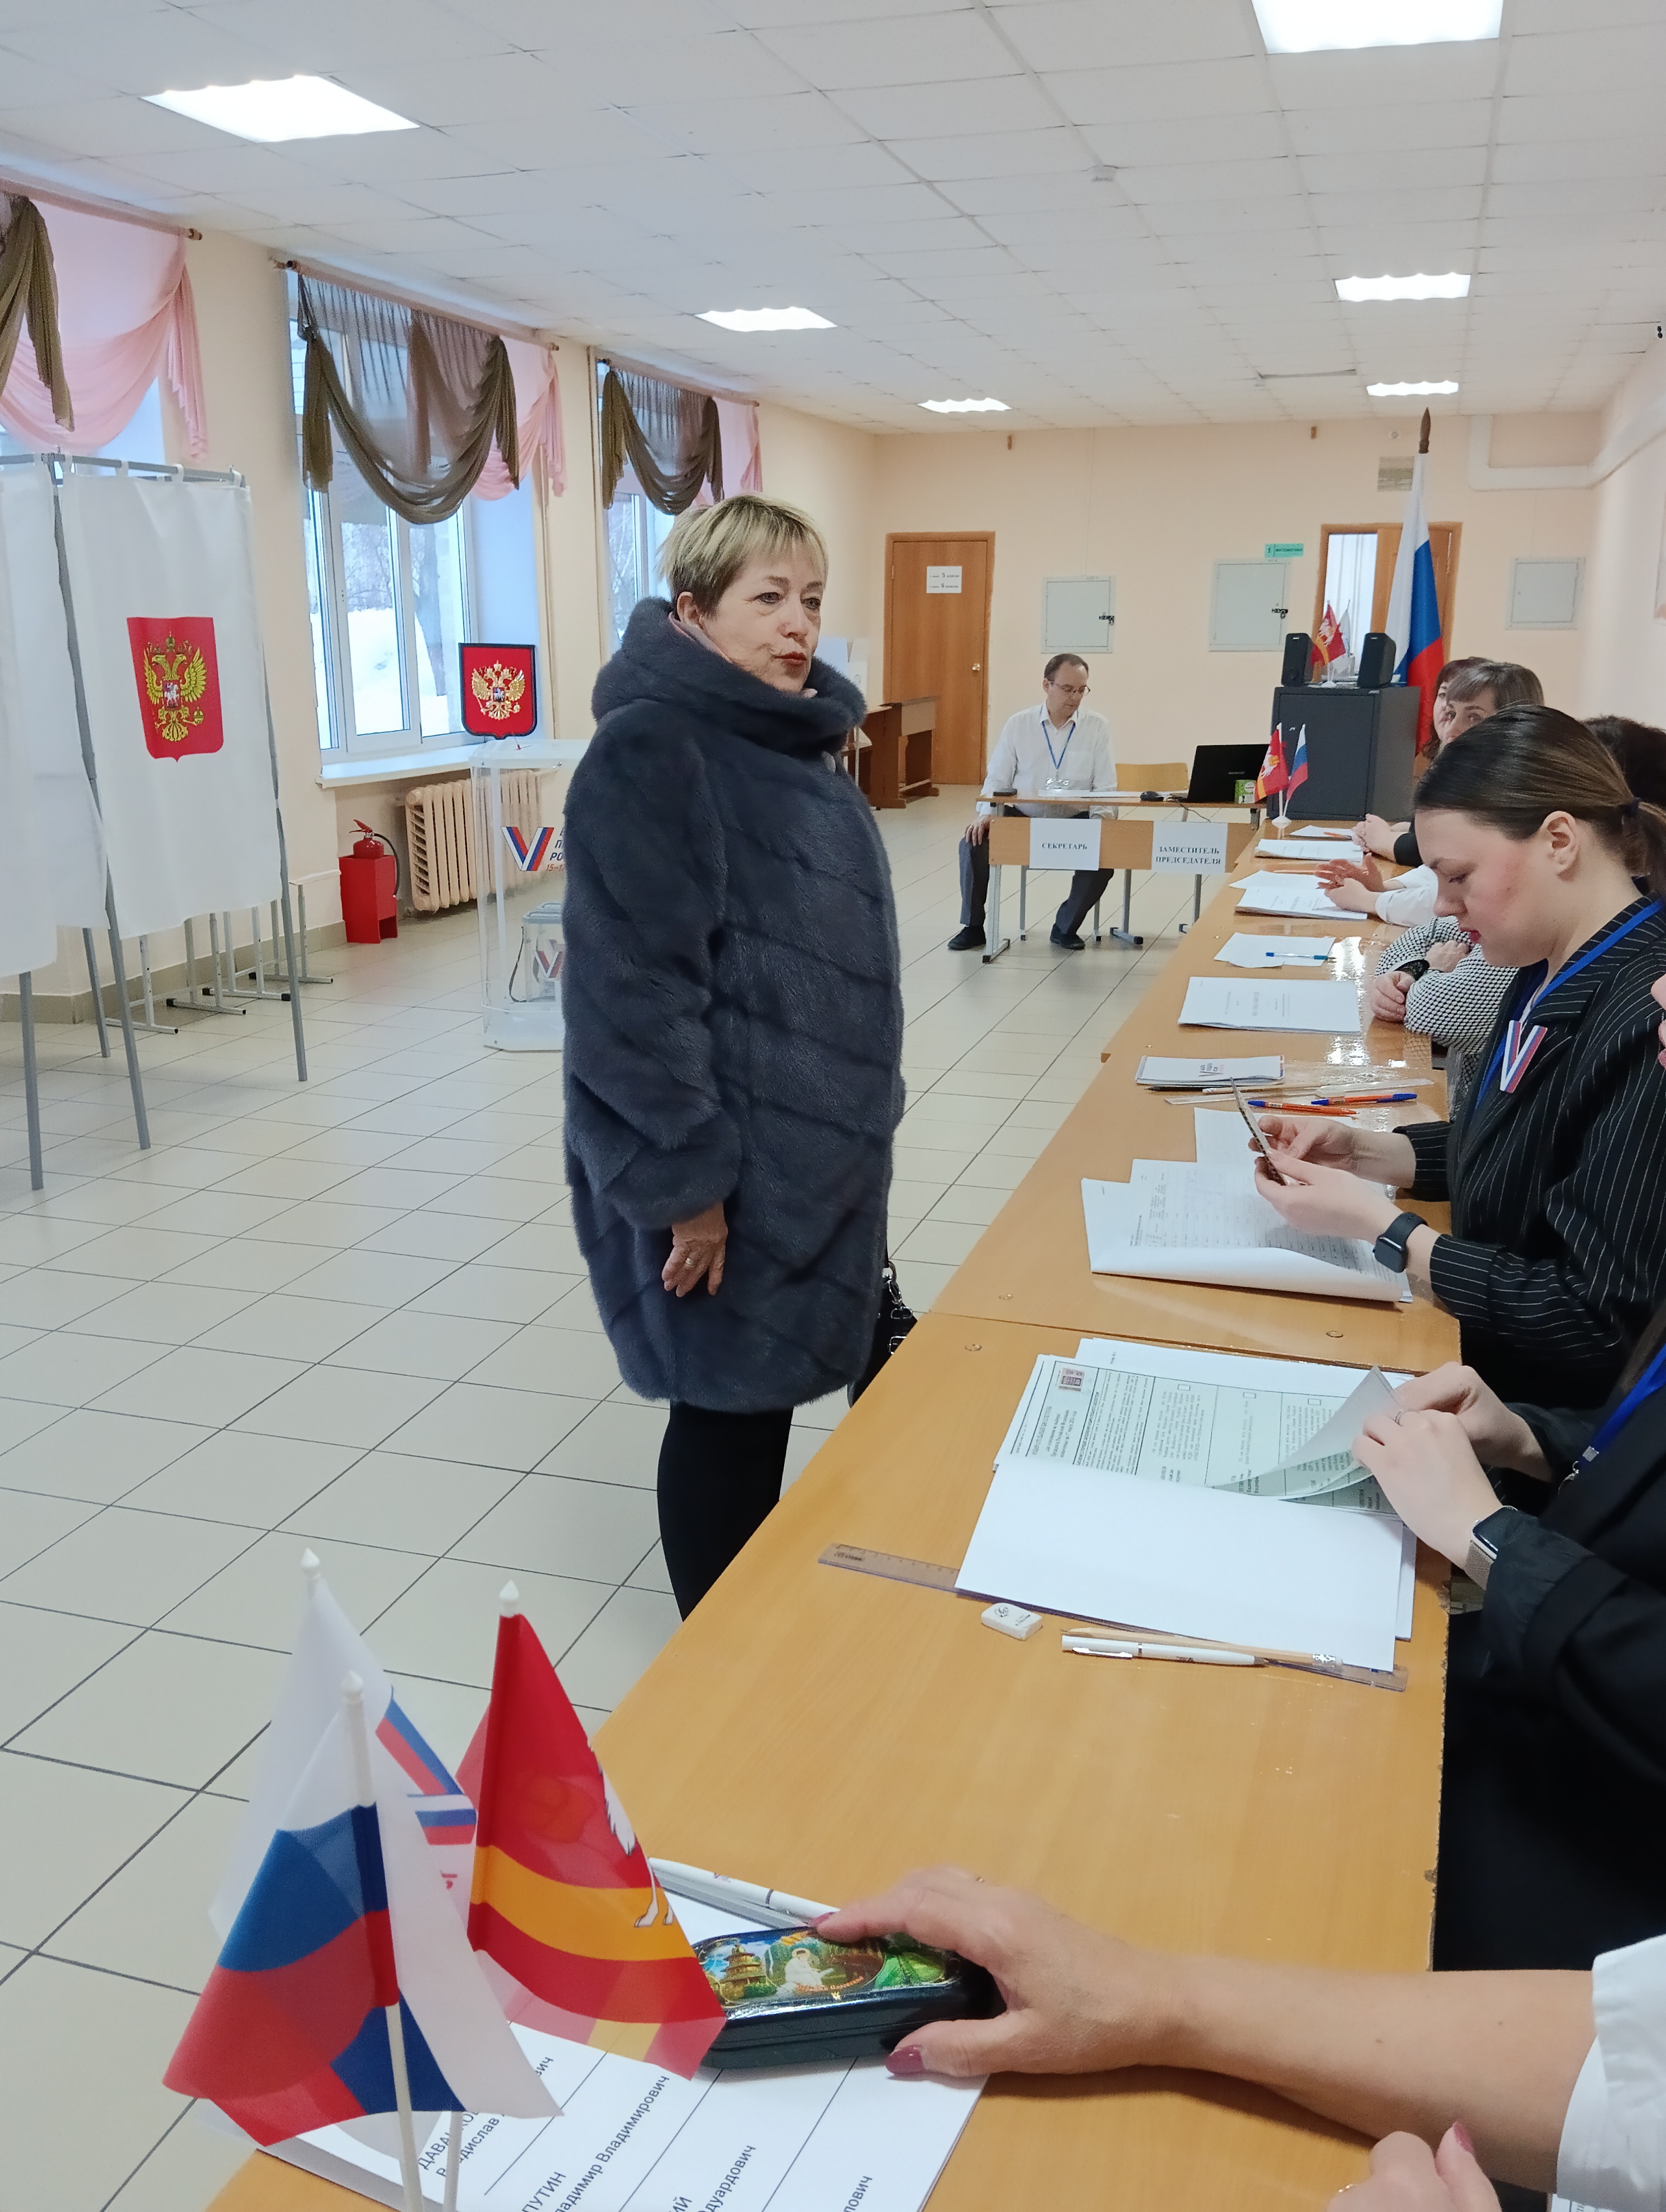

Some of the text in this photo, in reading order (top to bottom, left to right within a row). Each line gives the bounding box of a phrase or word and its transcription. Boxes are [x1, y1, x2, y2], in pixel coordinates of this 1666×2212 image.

[1156, 856, 1221, 865] ПРЕДСЕДАТЕЛЯ
[1158, 846, 1220, 854] ЗАМЕСТИТЕЛЬ
[554, 2075, 670, 2212] ладимир Владимирович
[522, 2171, 566, 2212] ПУТИН
[698, 2145, 756, 2212] дуардович
